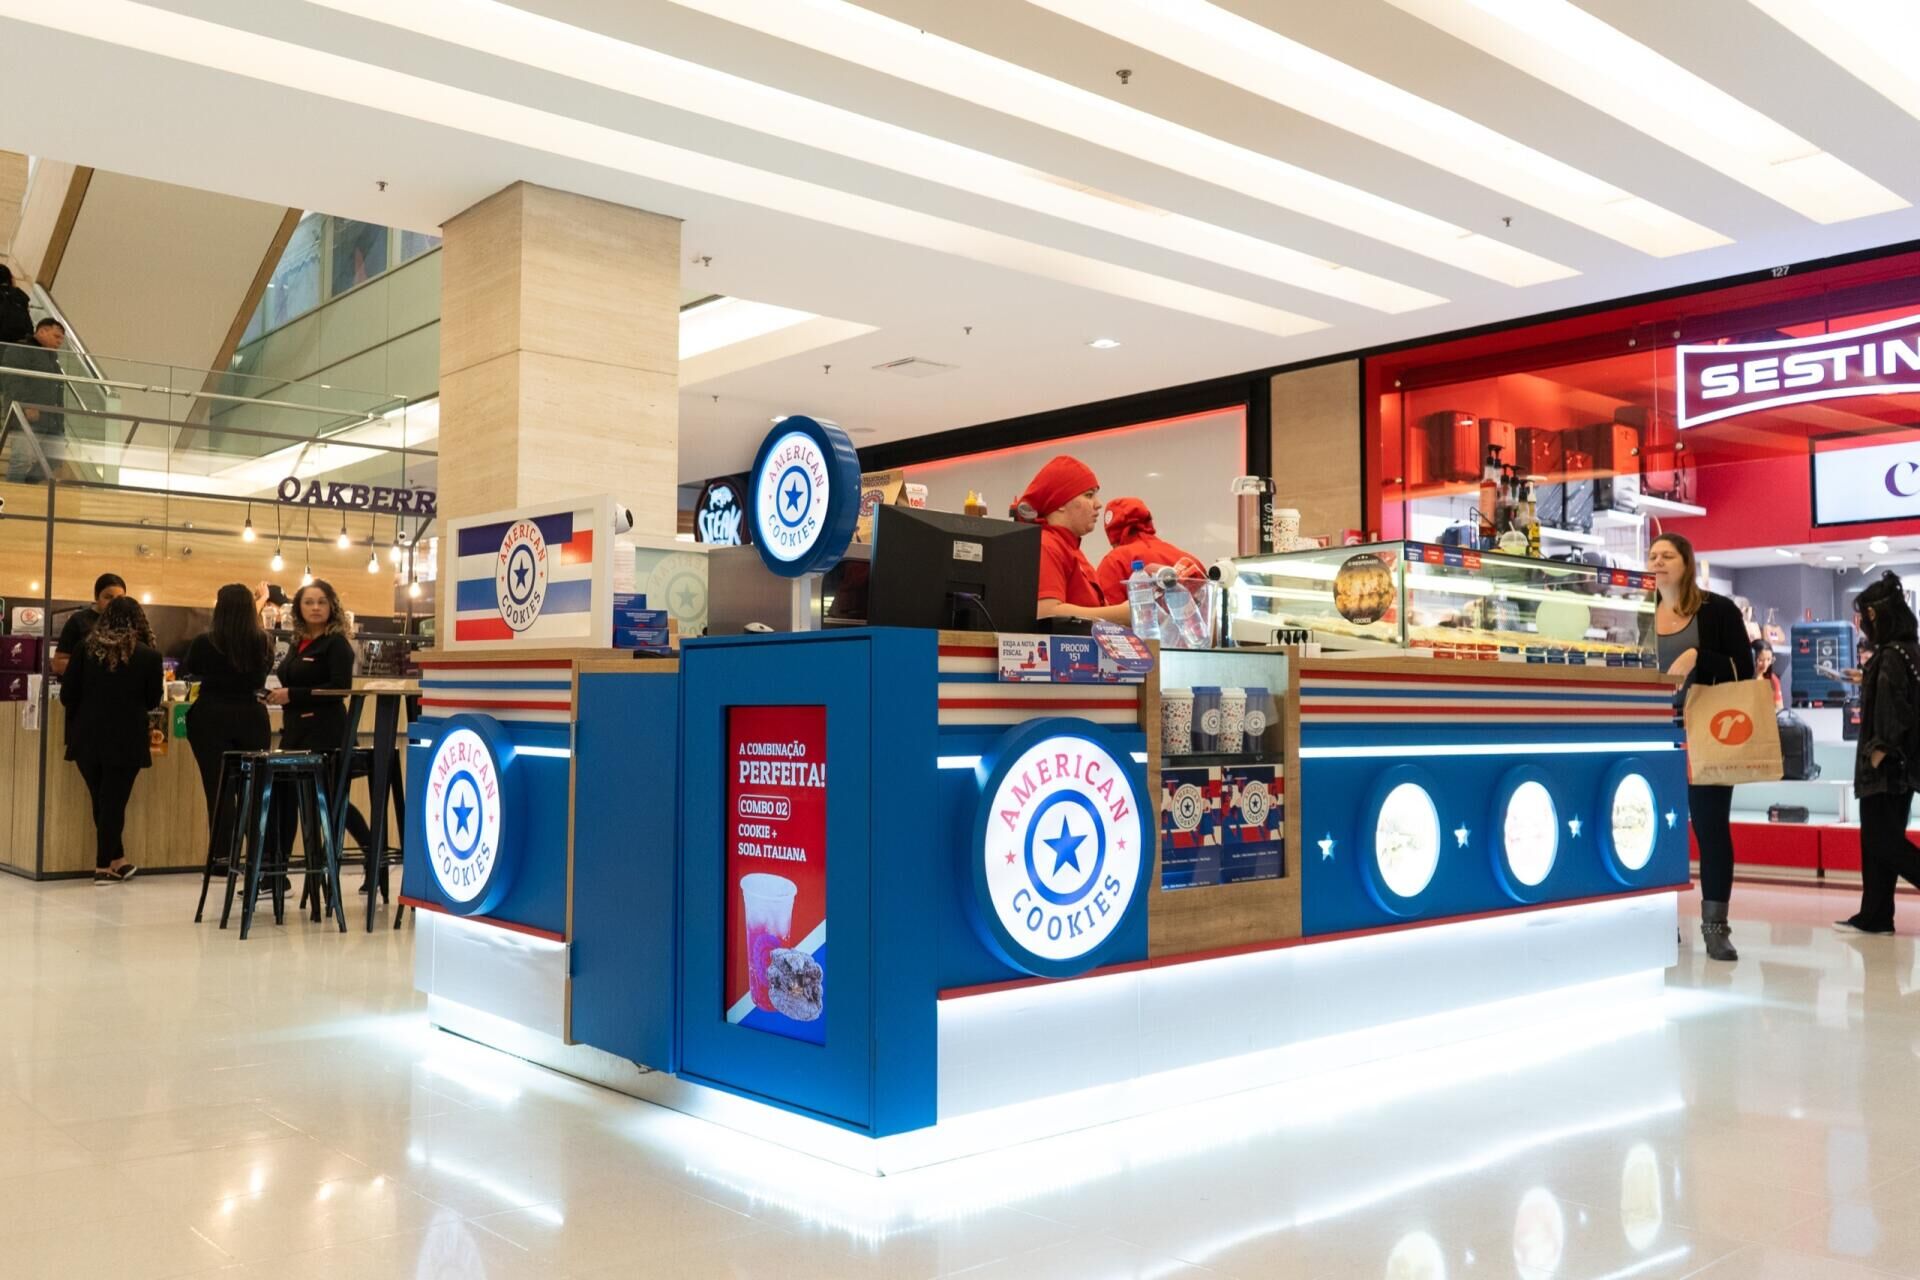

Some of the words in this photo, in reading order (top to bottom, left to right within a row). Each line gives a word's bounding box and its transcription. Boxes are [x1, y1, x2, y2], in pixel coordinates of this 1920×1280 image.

[1771, 265, 1790, 278] 127
[1700, 335, 1920, 400] SESTIN
[769, 445, 825, 489] AMERICAN
[277, 476, 437, 514] OAKBERR
[500, 523, 546, 566] AMERICAN
[768, 513, 817, 548] COOKIES
[502, 590, 541, 624] COOKIES
[1060, 643, 1090, 652] PROCON
[1069, 653, 1080, 661] 151
[739, 743, 745, 755] A
[747, 740, 806, 759] COMBINAÇÃO
[433, 742, 496, 800] AMERICAN
[739, 761, 826, 788] PERFEITA!
[740, 800, 774, 815] COMBO
[776, 802, 788, 815] 02
[1000, 753, 1130, 832] AMERICAN
[738, 824, 770, 839] COOKIE
[437, 841, 491, 887] COOKIES
[738, 842, 762, 857] SODA
[763, 845, 807, 862] ITALIANA
[1012, 874, 1121, 941] COOKIES
